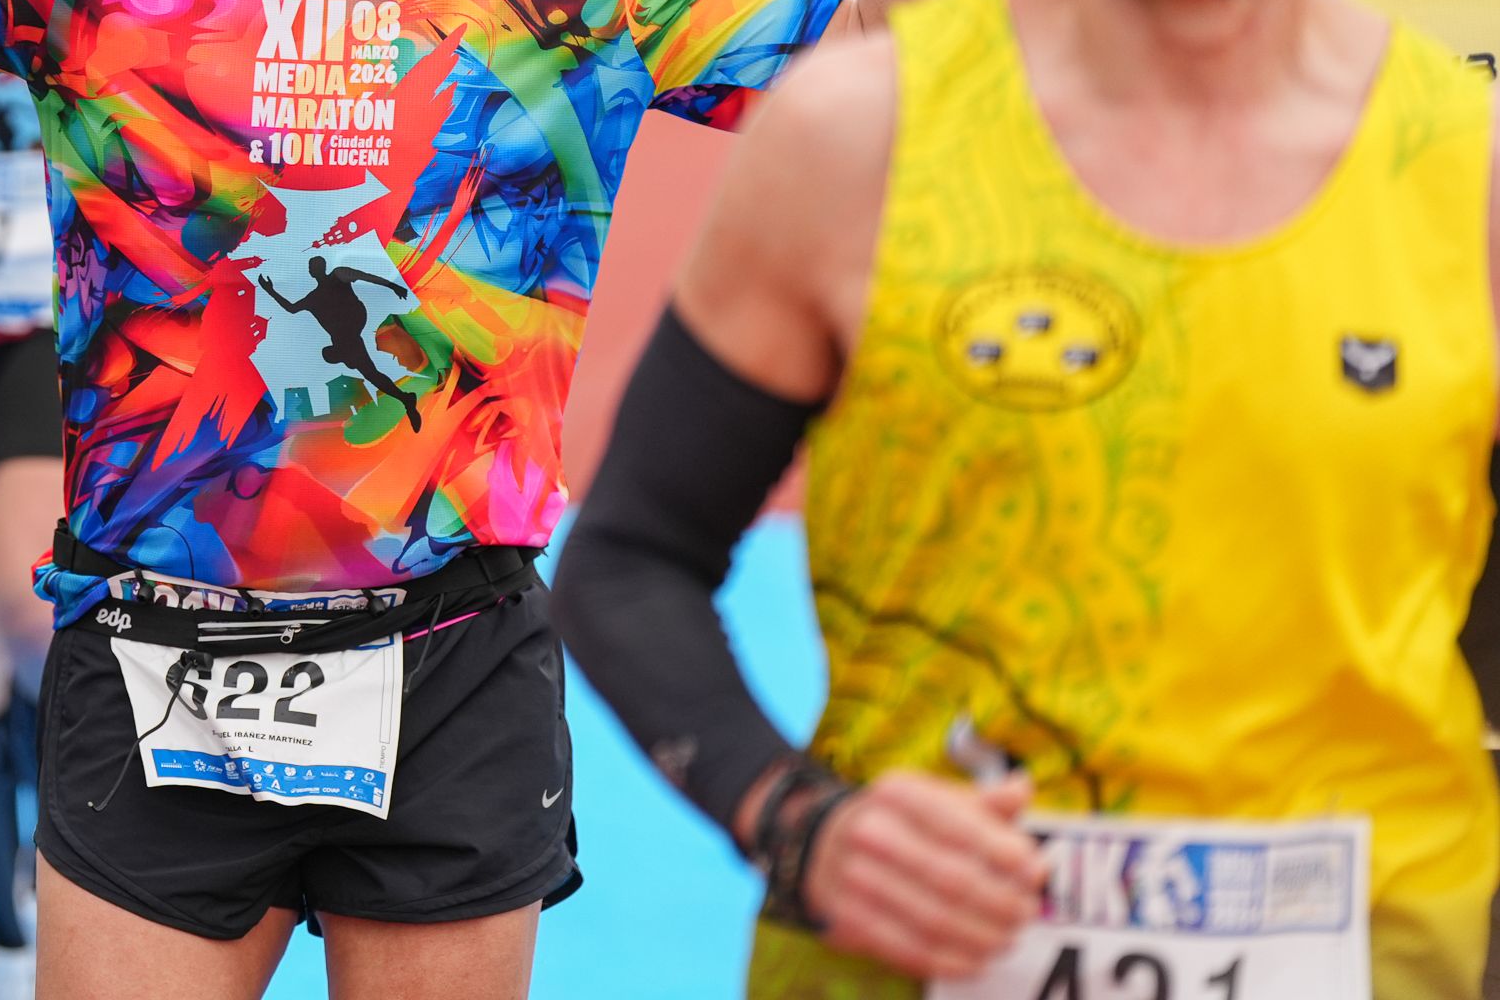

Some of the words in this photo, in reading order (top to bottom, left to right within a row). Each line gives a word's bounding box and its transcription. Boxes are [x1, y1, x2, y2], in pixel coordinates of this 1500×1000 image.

[352, 0, 401, 41] 08
[351, 45, 399, 60] MARZO
[253, 62, 347, 95] MEDIA
[350, 64, 398, 84] 2026
[250, 91, 396, 131] MARATÓN
[249, 139, 264, 164] &
[269, 132, 325, 165] 10K
[329, 135, 373, 148] Ciudad
[375, 135, 392, 148] de
[329, 149, 390, 166] LUCENA
[95, 607, 132, 633] edp
[166, 660, 326, 727] 622
